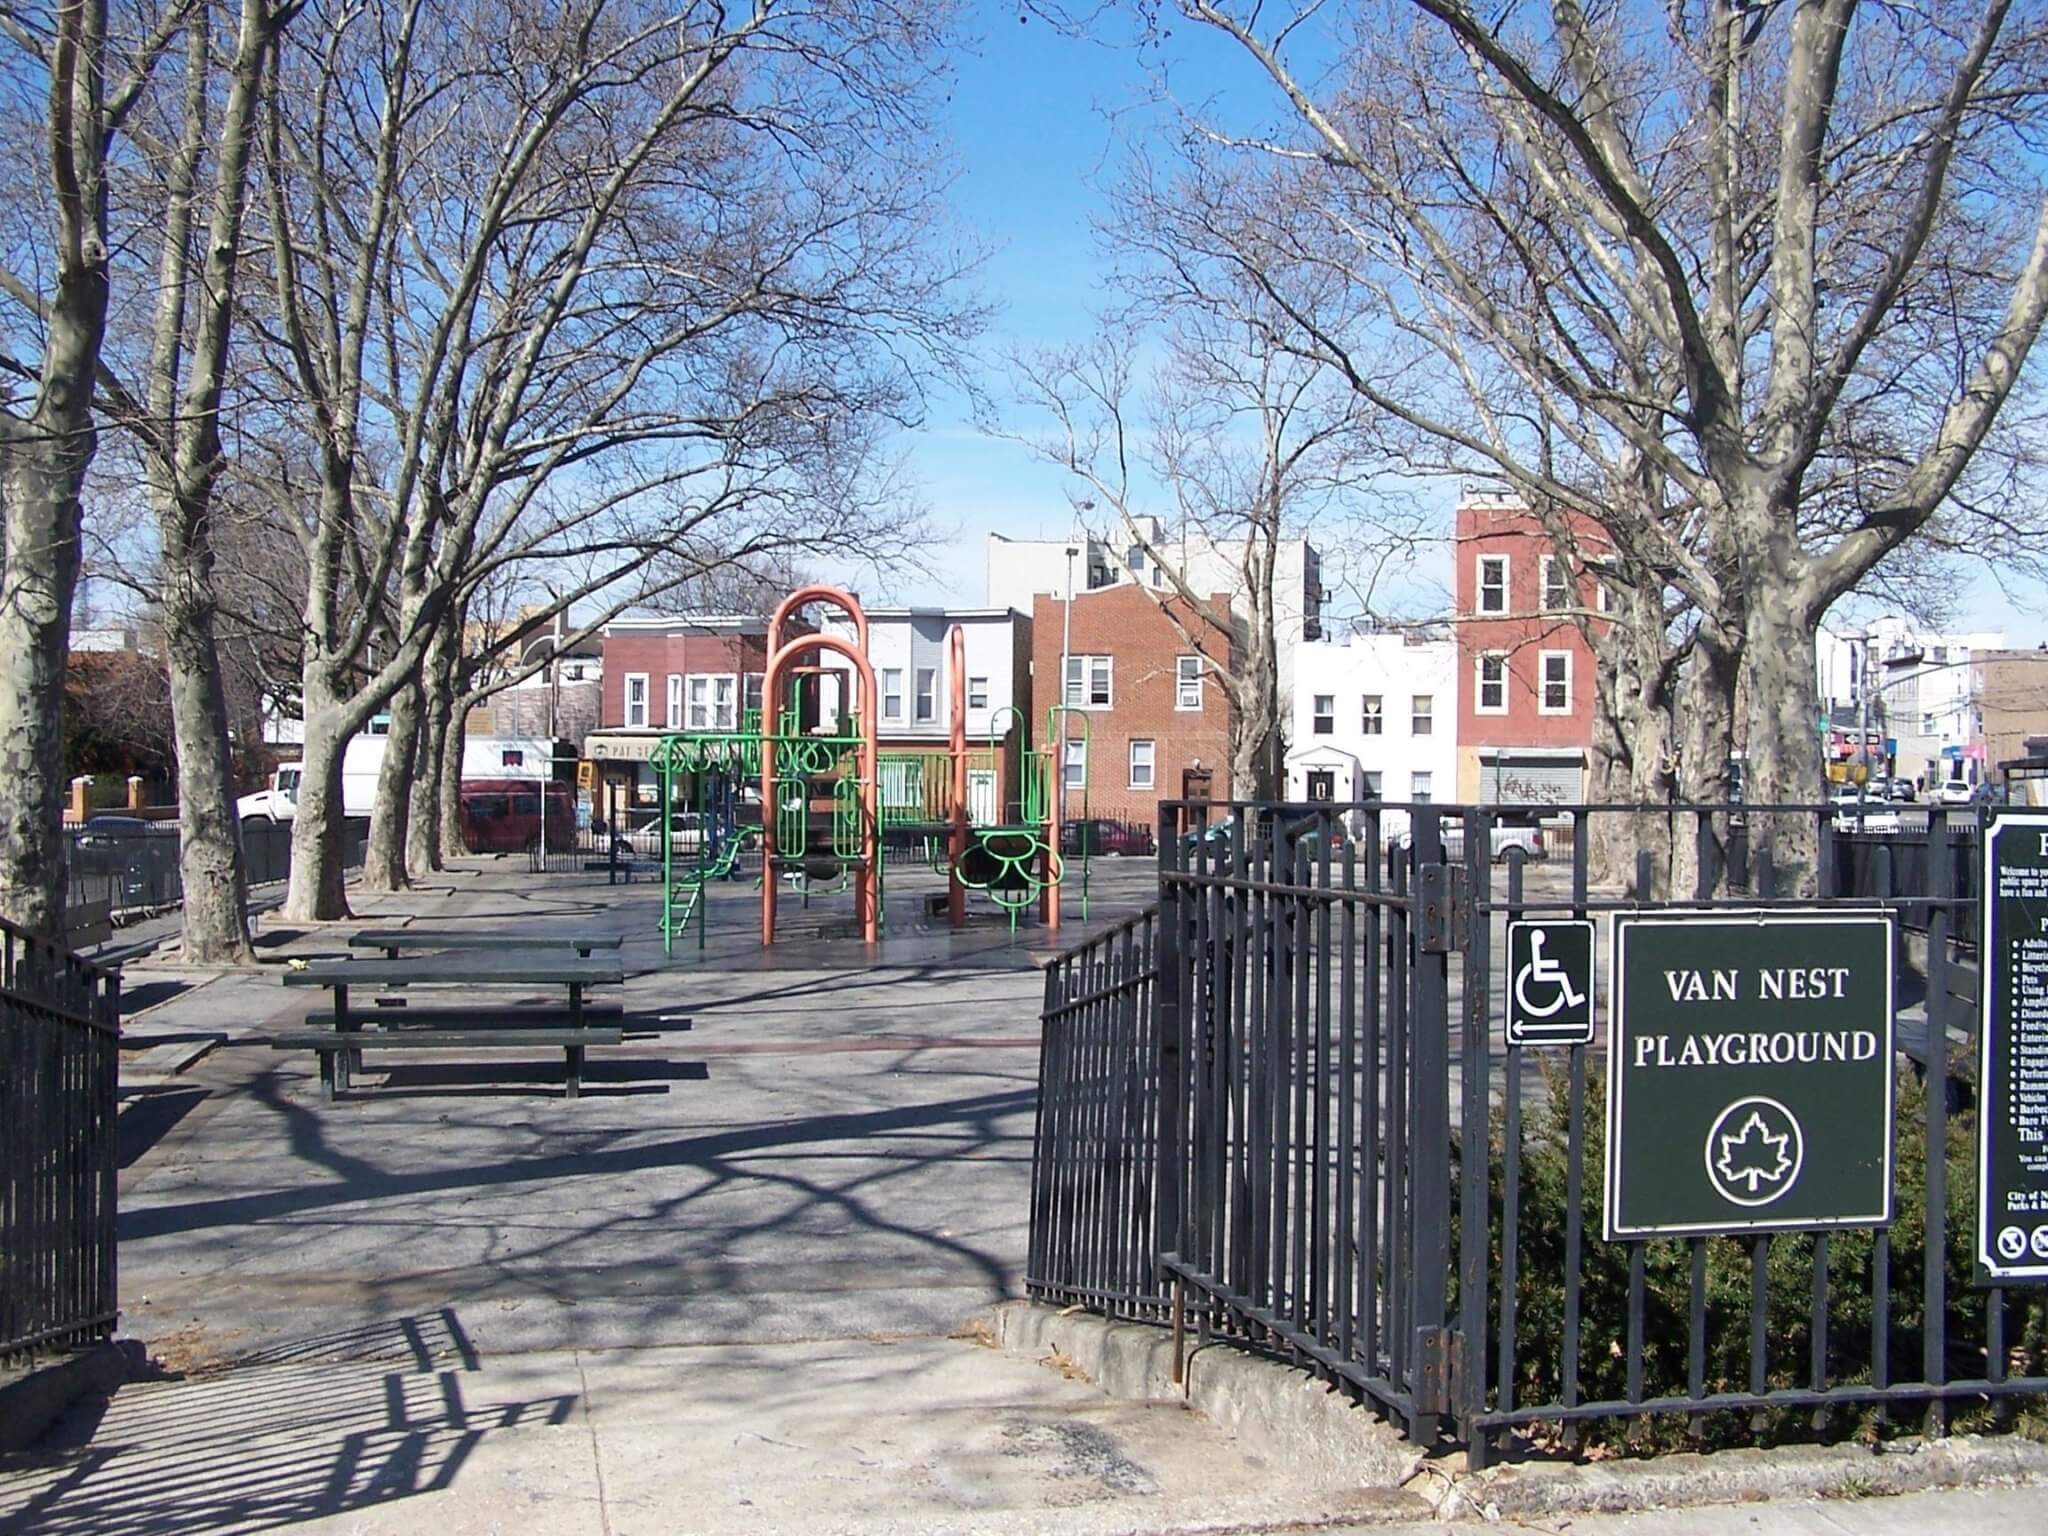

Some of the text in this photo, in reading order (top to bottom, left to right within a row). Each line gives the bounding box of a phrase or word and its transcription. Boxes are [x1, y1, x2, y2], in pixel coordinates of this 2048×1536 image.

[1664, 968, 1850, 1002] VAN NEST
[1633, 1030, 1878, 1067] PLAYGROUND
[2017, 1127, 2044, 1142] This
[2007, 1191, 2026, 1202] City
[2028, 1191, 2039, 1201] of
[2007, 1201, 2030, 1211] Parks
[2031, 1201, 2039, 1210] &
